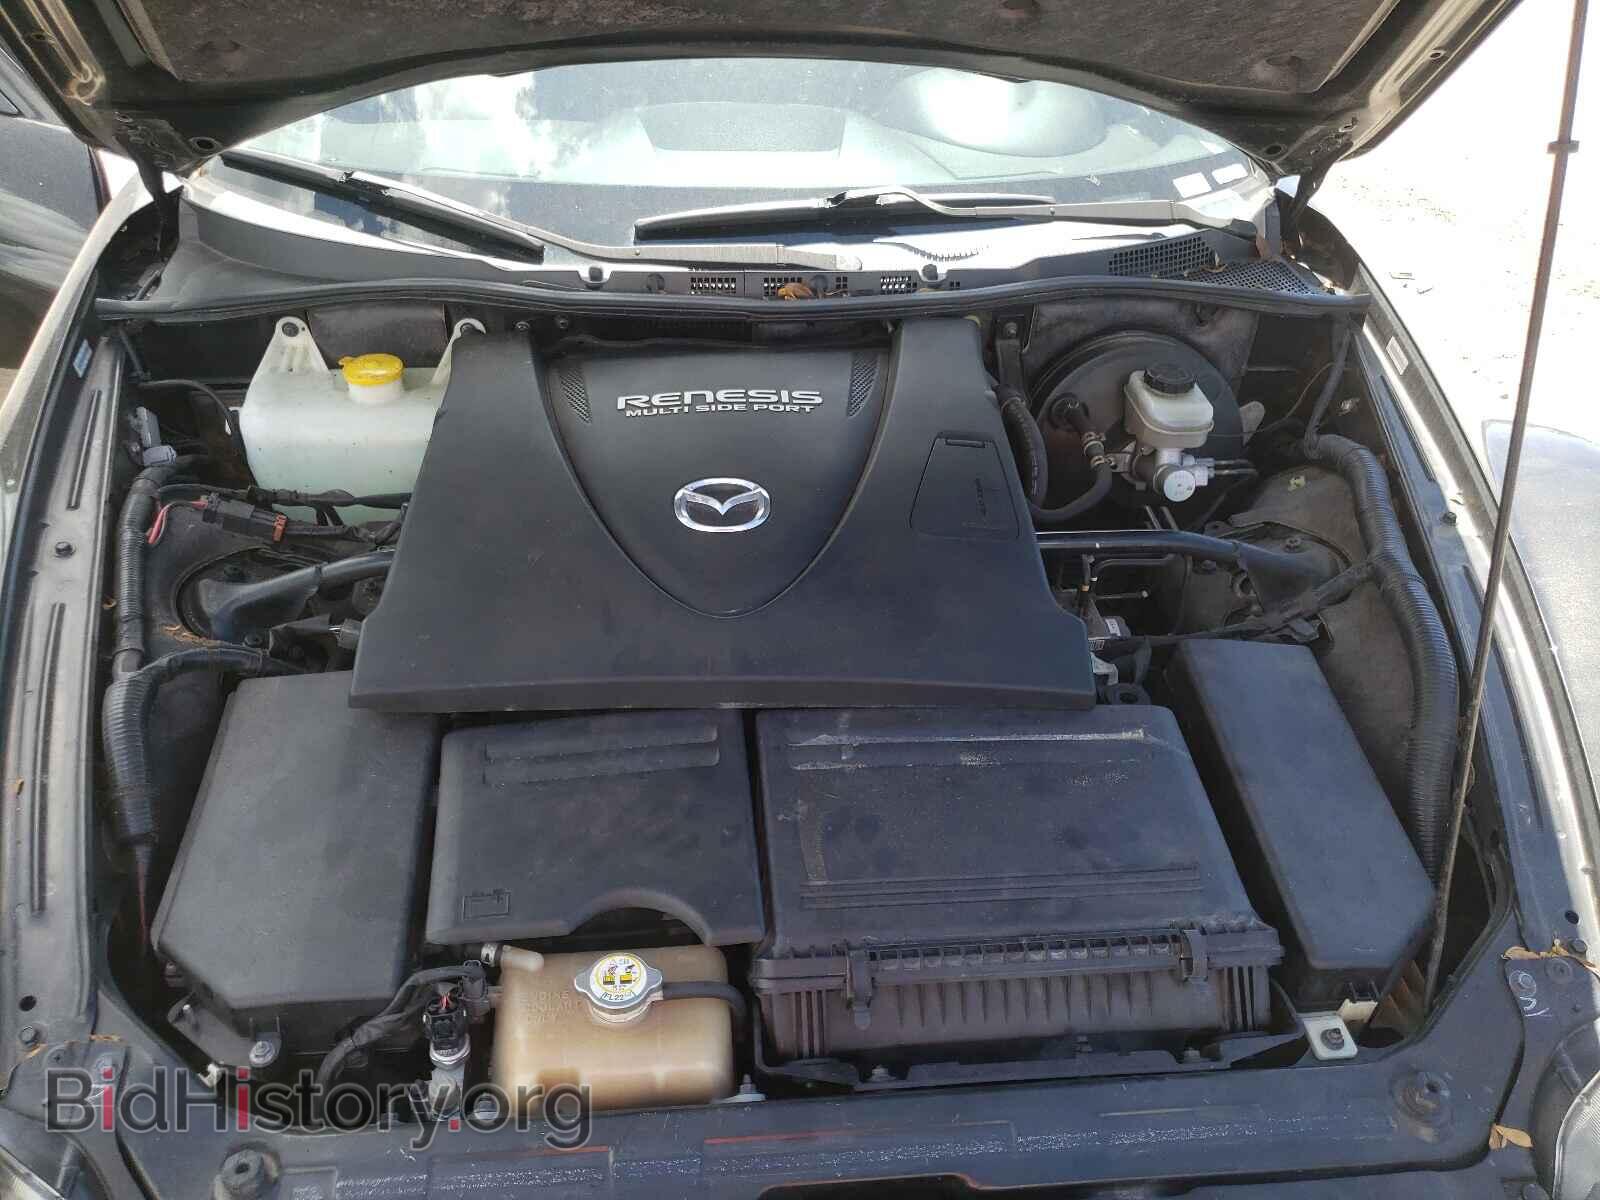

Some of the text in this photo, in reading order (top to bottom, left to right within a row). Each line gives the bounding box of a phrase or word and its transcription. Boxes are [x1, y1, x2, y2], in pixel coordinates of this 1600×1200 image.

[616, 389, 824, 410] RENESIS
[625, 403, 815, 417] MULTI SIDE PORT
